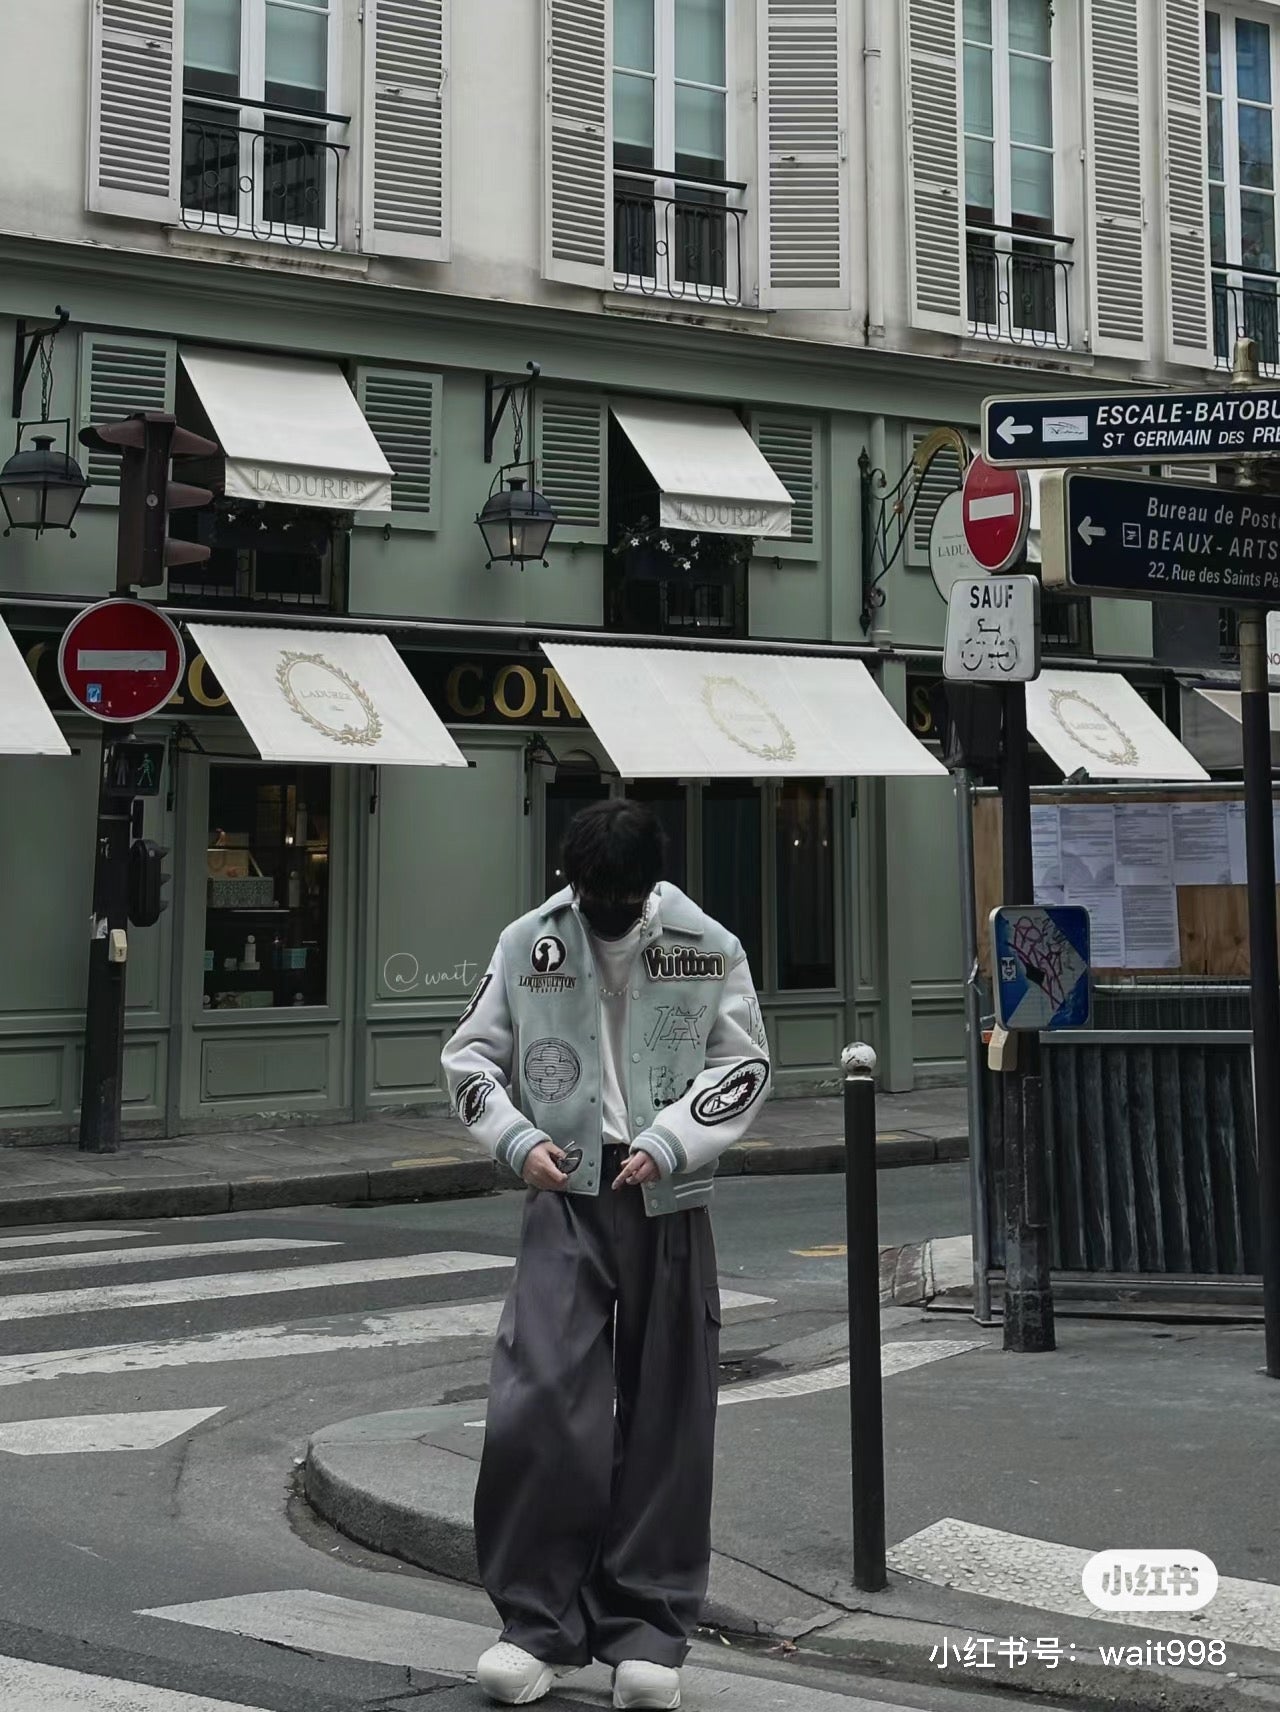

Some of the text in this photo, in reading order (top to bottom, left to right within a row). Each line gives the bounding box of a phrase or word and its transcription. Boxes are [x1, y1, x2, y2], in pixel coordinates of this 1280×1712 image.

[1134, 429, 1212, 447] GERMAIN
[1218, 431, 1245, 444] DES
[1147, 497, 1280, 529] Bureau de Post
[938, 543, 970, 557] LADU
[1172, 564, 1196, 582] Rue
[1199, 567, 1220, 584] des
[1223, 568, 1261, 587] Saints
[1264, 572, 1280, 588] Pè
[970, 585, 1013, 608] SAUF
[642, 946, 726, 979] Vuitton
